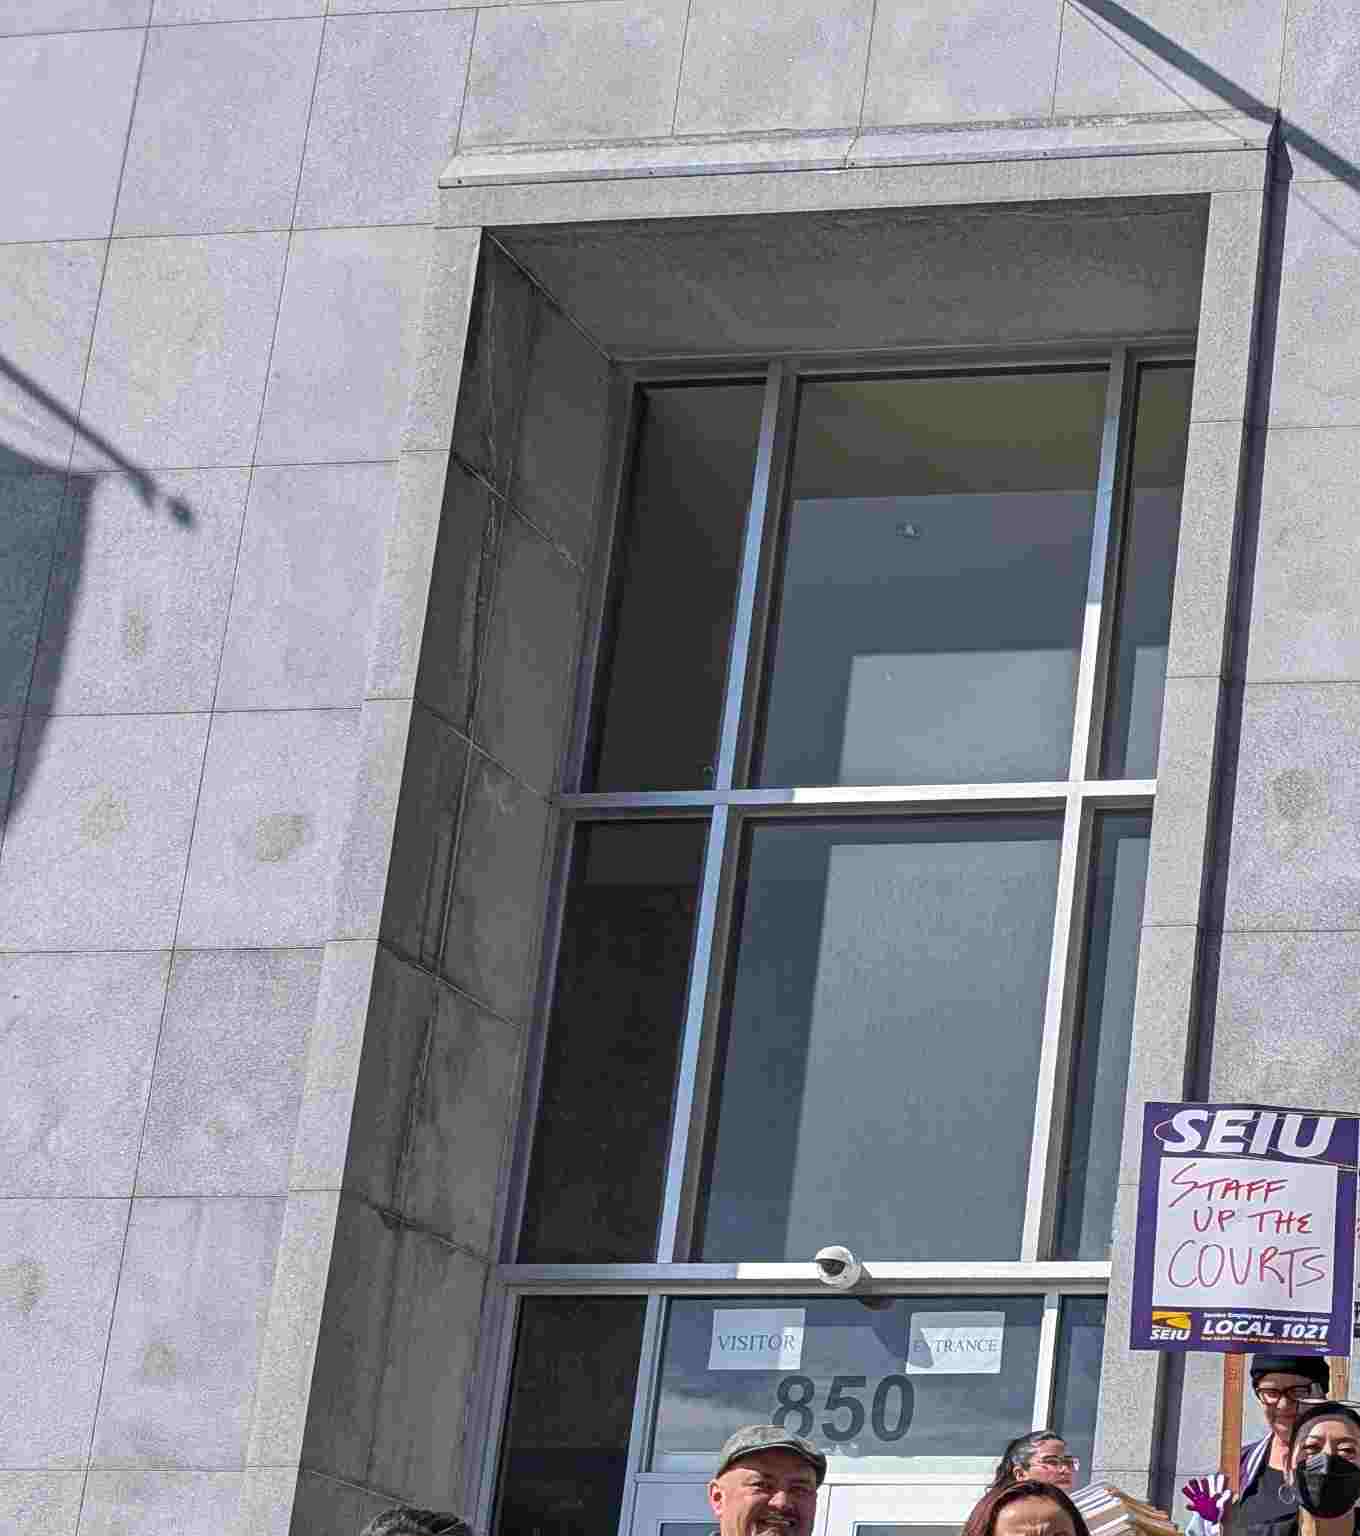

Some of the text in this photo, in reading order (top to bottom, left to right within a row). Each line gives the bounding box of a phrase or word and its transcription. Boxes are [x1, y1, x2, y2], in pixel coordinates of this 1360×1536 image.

[1163, 1108, 1337, 1158] SEIU
[1168, 1161, 1289, 1208] STAFF
[1193, 1206, 1313, 1234] UP THE
[1168, 1239, 1327, 1299] COURTS
[718, 1333, 795, 1352] VISITOR
[1150, 1327, 1192, 1341] SEIU
[1202, 1319, 1329, 1340] LOCAL 1021
[772, 1374, 915, 1442] 850
